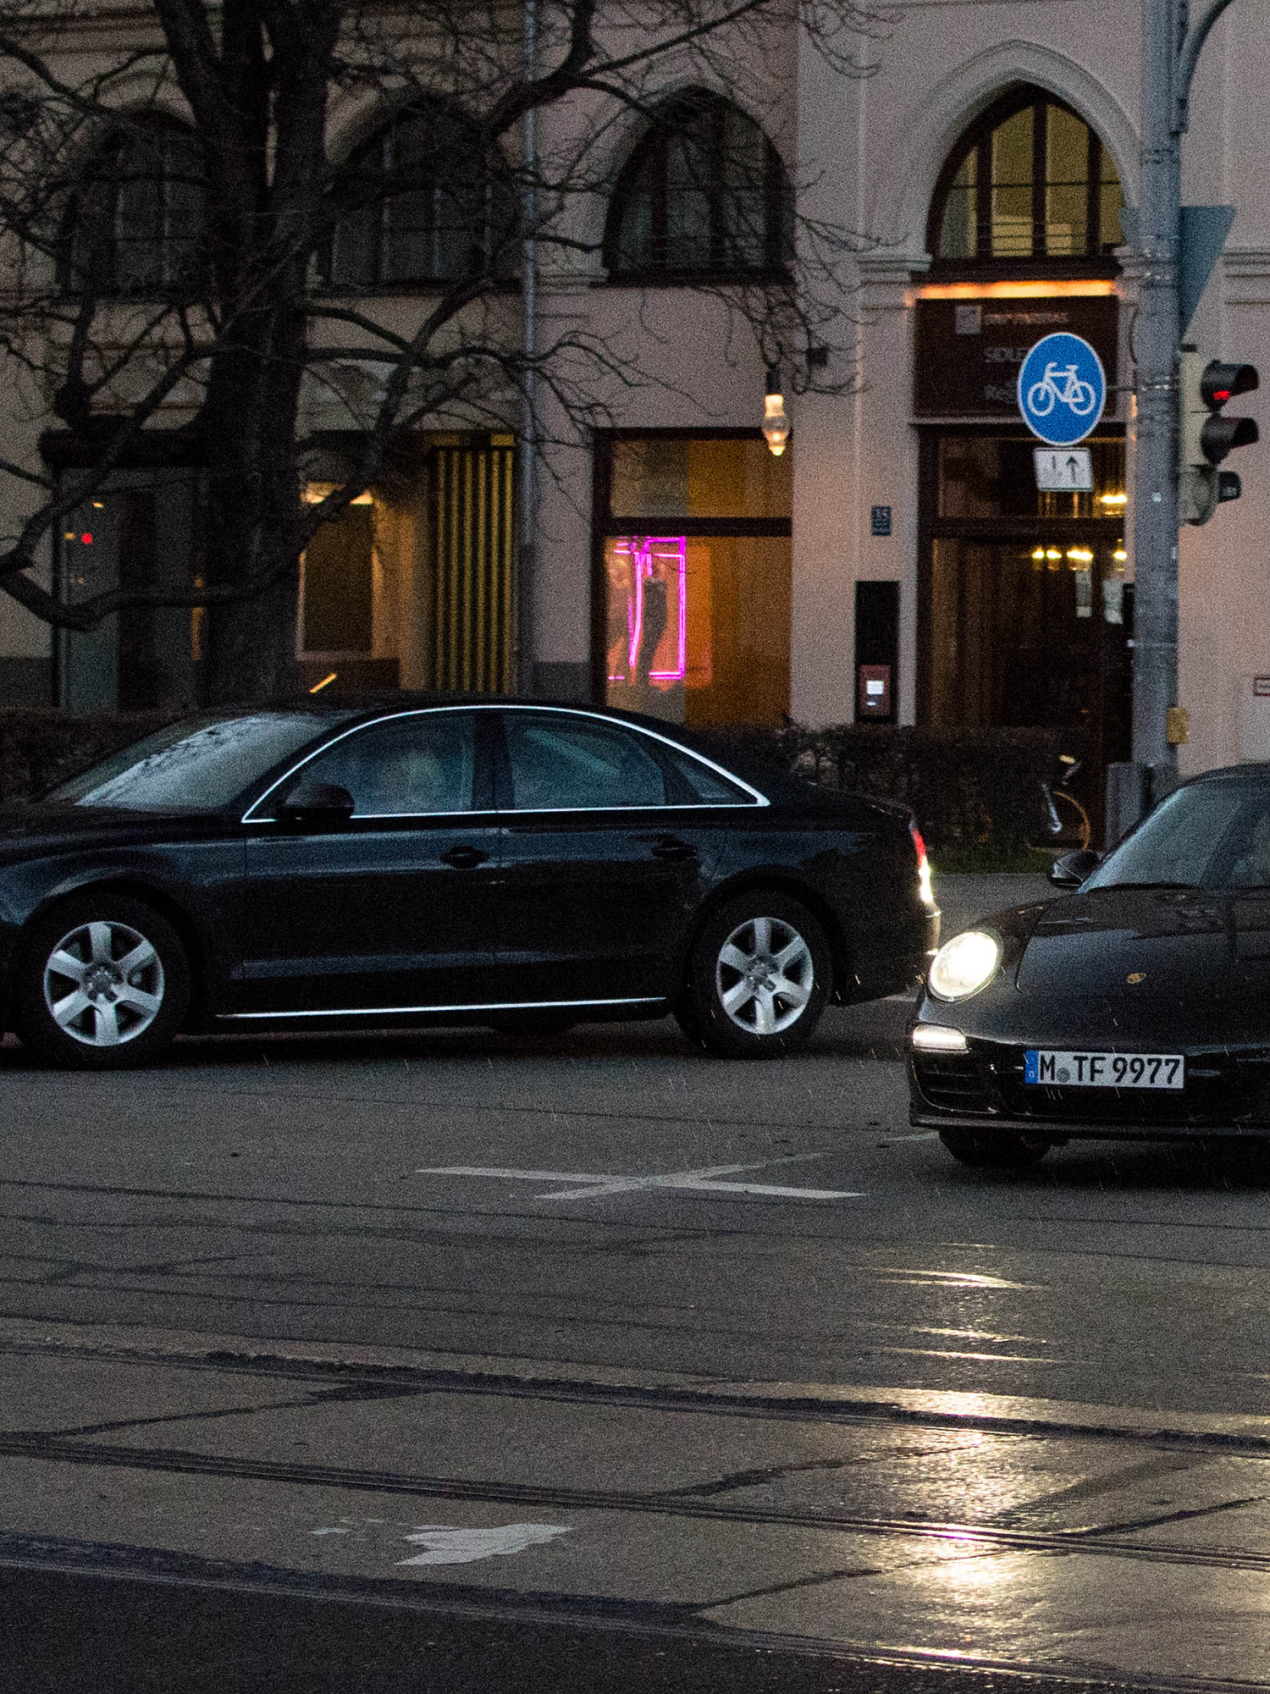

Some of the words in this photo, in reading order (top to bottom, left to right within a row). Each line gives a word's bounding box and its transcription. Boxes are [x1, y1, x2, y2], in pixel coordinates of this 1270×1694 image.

[1040, 1054, 1056, 1082] M
[1073, 1055, 1107, 1083] TF
[1111, 1056, 1181, 1085] 9977
